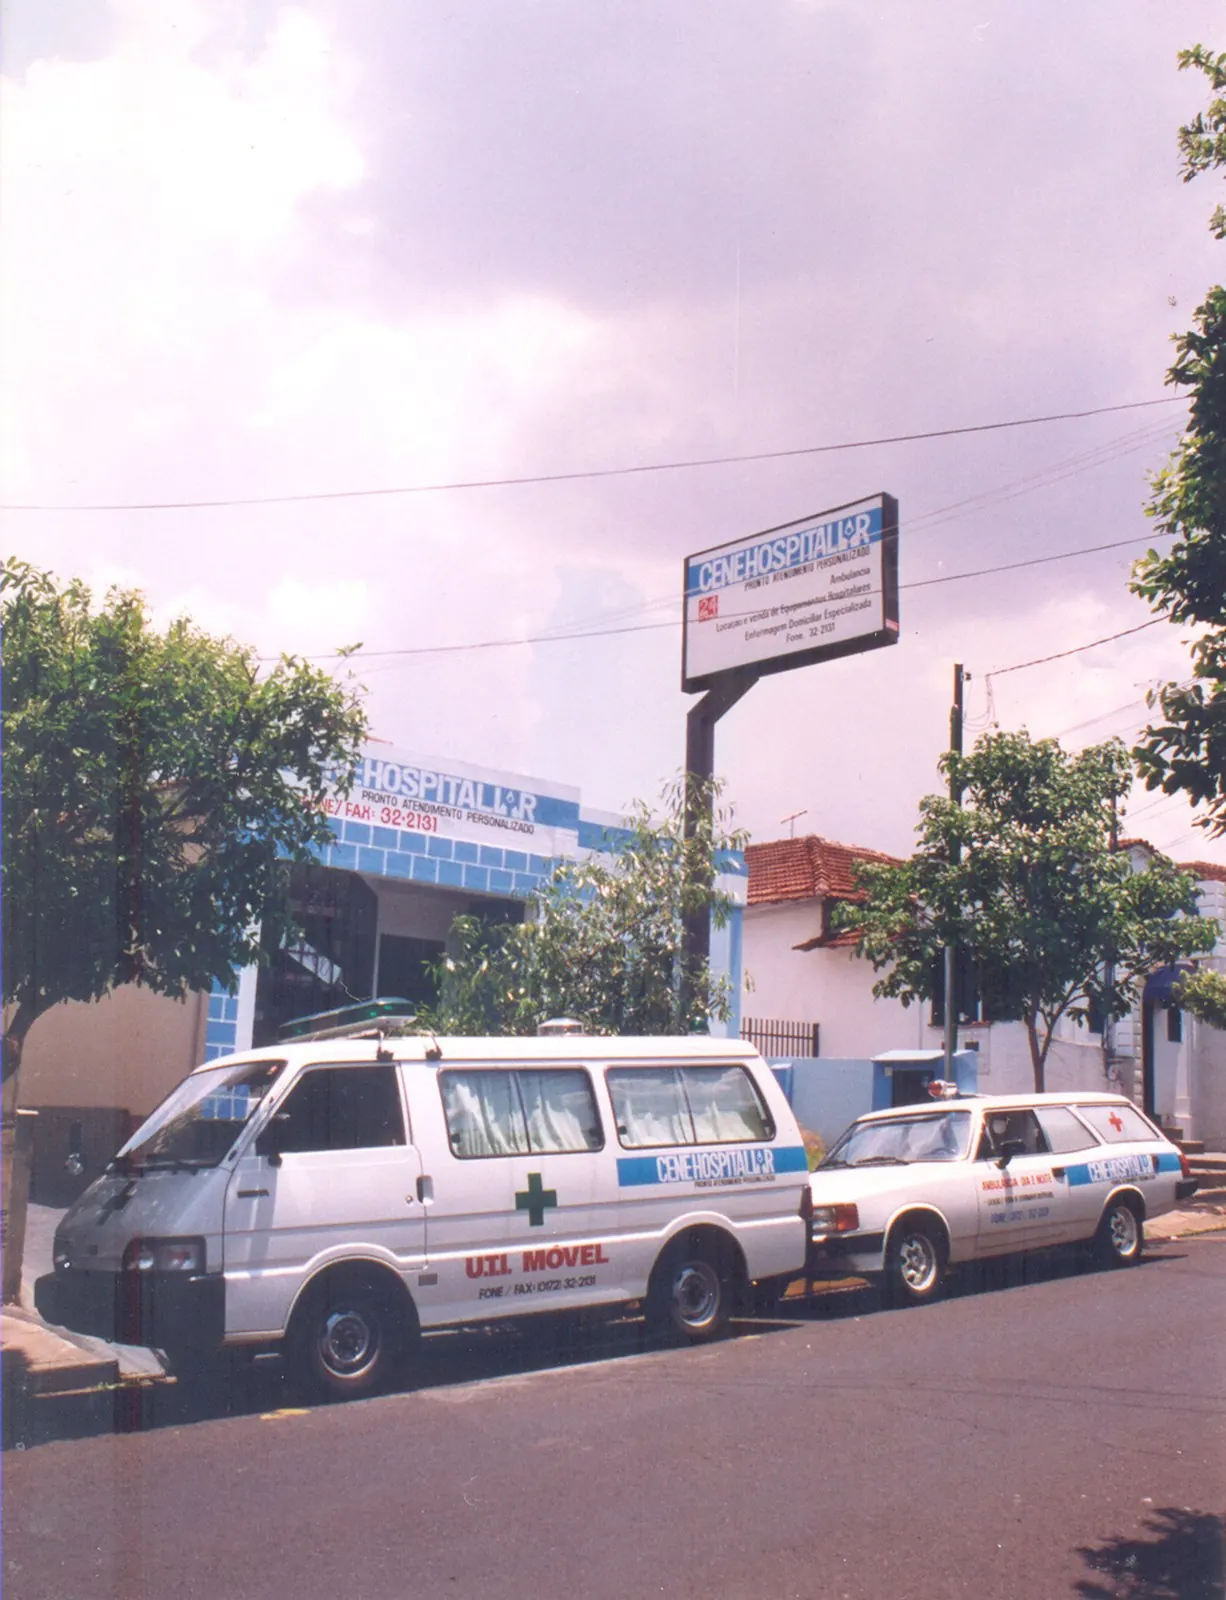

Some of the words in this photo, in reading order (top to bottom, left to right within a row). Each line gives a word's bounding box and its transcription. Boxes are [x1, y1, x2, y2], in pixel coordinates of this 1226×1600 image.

[744, 576, 770, 591] PRONTO
[773, 562, 815, 583] ATENDIMENTO
[817, 546, 871, 571] PERSONALIZADO
[744, 623, 787, 641] Enfermagem
[824, 598, 872, 621] Especializada
[362, 789, 398, 807] PRONTO
[402, 799, 463, 820] ATENDIMENTO
[467, 811, 534, 835] PERSONALIZADO
[466, 1253, 512, 1279] U.T.I.
[522, 1244, 609, 1272] MÓVEL
[479, 1286, 504, 1299] FONE
